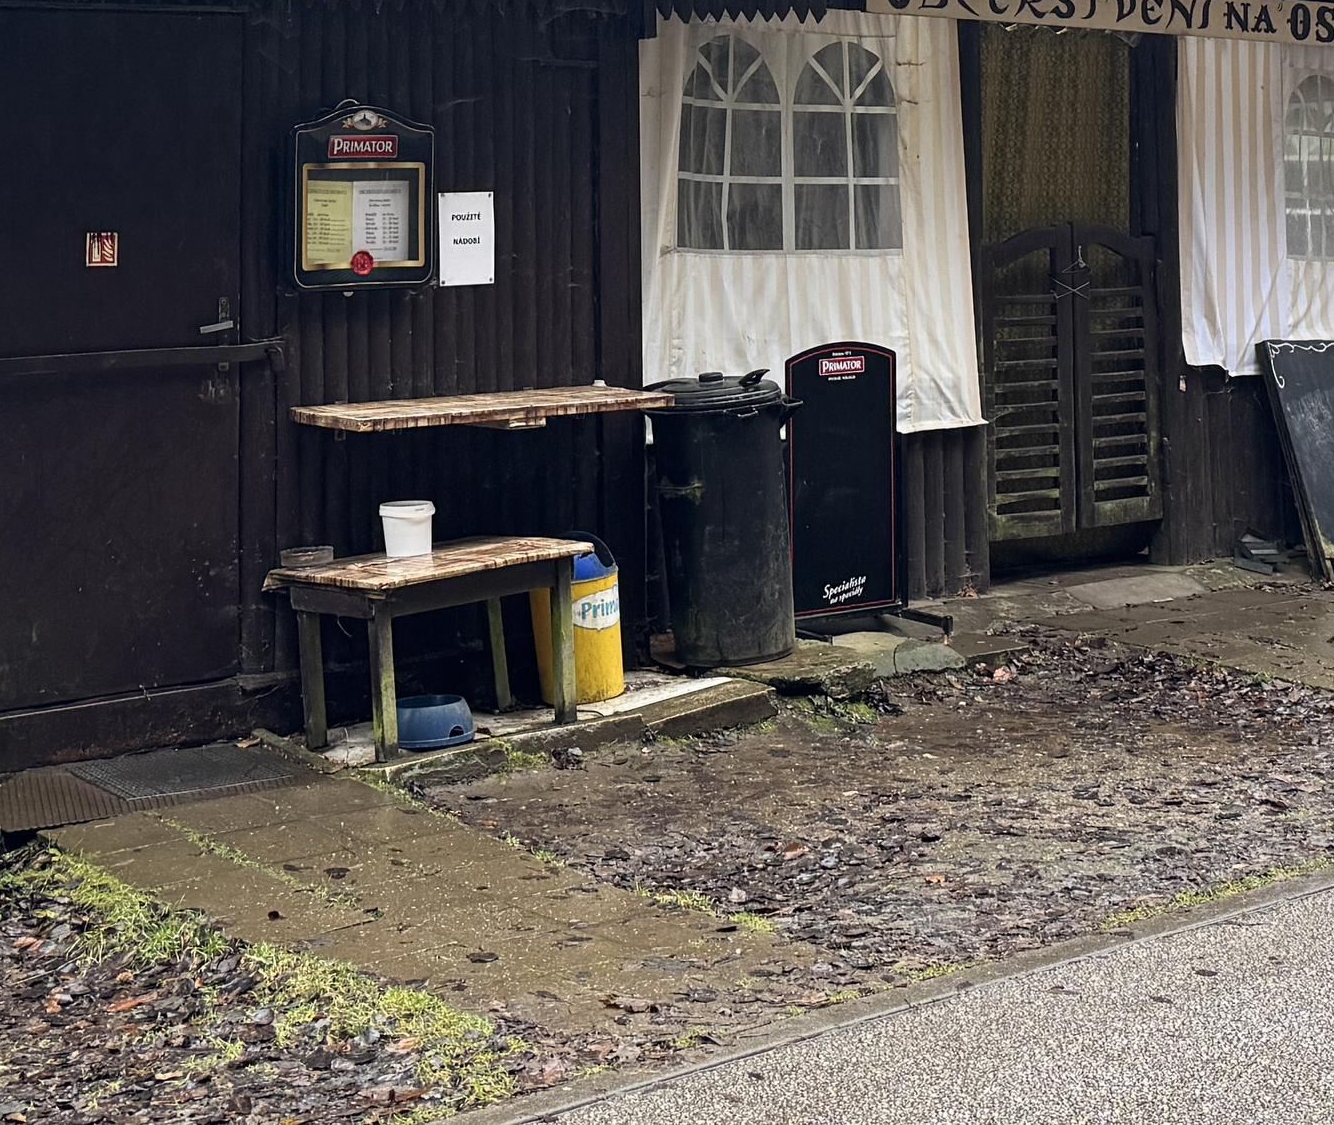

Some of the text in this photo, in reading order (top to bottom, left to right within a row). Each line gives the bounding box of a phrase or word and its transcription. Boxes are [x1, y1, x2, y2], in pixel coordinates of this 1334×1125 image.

[1224, 1, 1277, 34] NA
[333, 138, 393, 155] PRIMATOR
[822, 360, 861, 373] PRIMATOR
